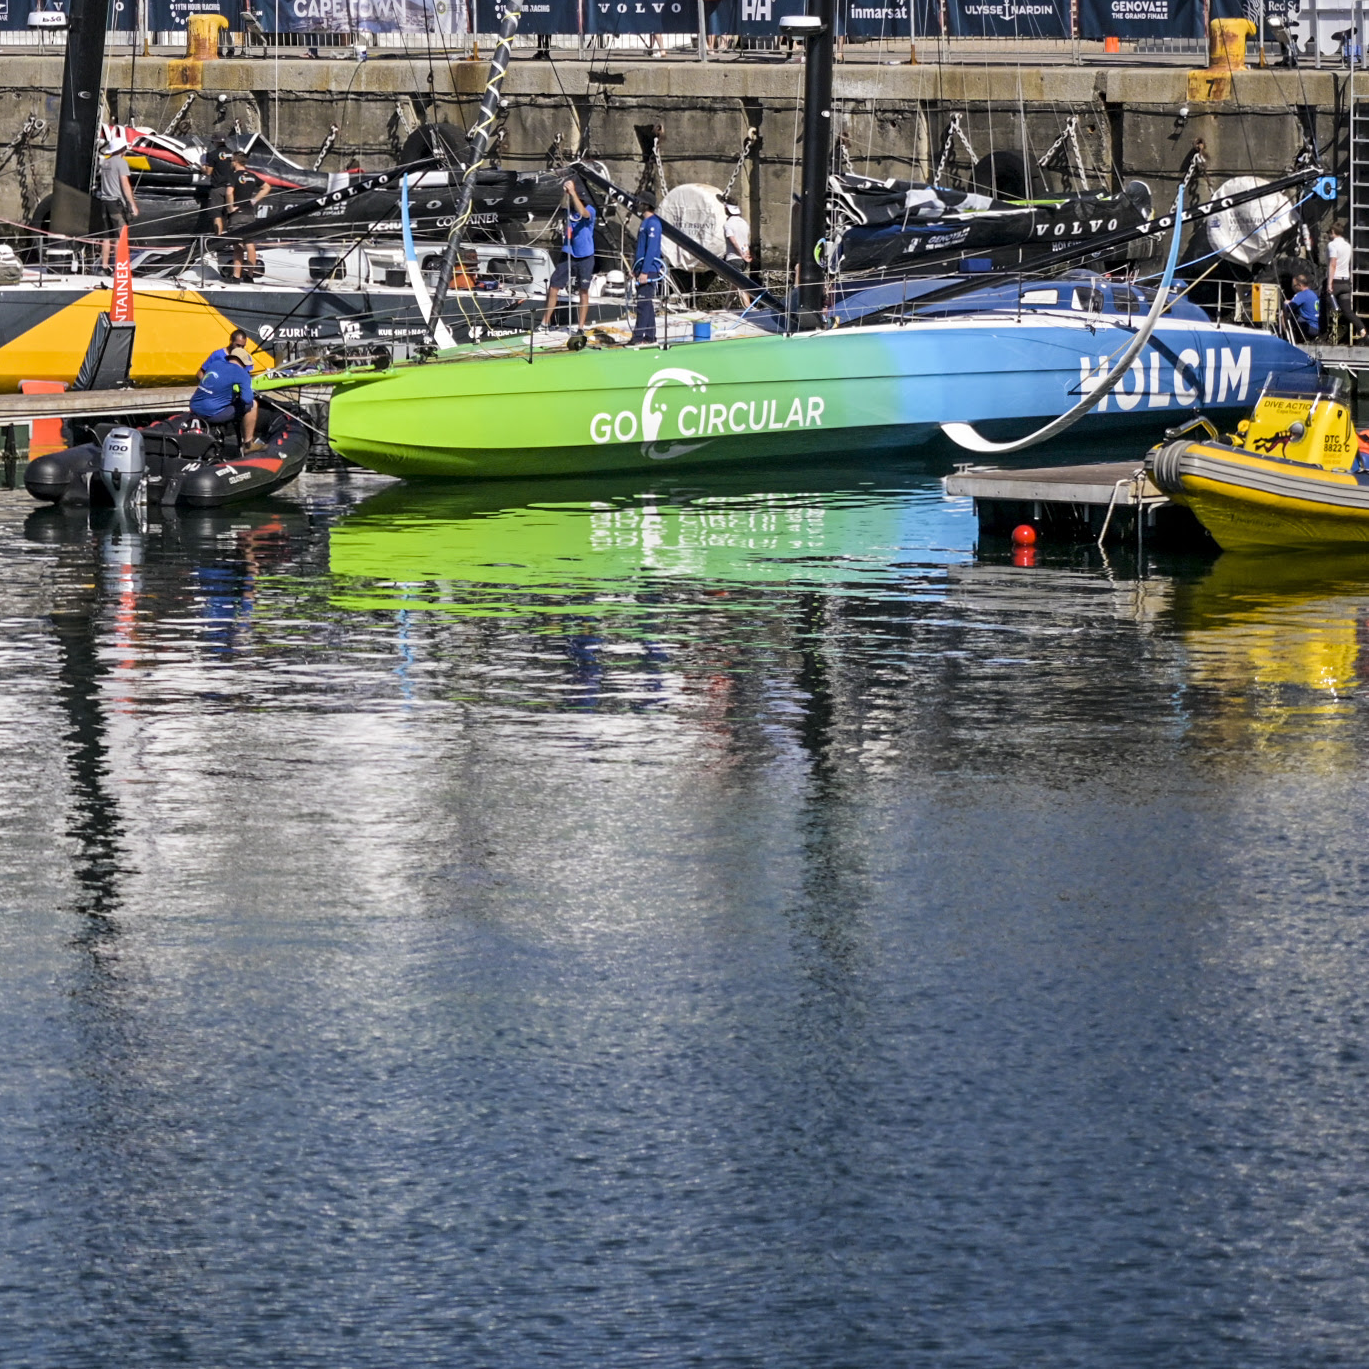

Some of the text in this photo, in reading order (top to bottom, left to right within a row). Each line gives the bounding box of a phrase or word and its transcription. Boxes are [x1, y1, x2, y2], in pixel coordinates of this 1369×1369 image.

[598, 3, 682, 14] VOLVO
[851, 3, 907, 19] inmarsat
[965, 5, 1053, 15] ULYSSE NARDIN
[1111, 0, 1155, 12] GENOVA
[1268, 0, 1286, 12] Red
[1126, 12, 1147, 20] GRAND
[1205, 79, 1215, 98] 7
[316, 175, 388, 207] VOLVO
[1036, 218, 1118, 236] VOLVO
[279, 327, 319, 338] ZURICH
[1079, 346, 1252, 412] HOLCIM
[1264, 400, 1313, 411] DIVE ACTIO
[590, 395, 825, 445] GO CIRCULAR
[1324, 435, 1340, 444] DTC
[108, 443, 129, 453] 100
[1324, 443, 1342, 452] 8822
